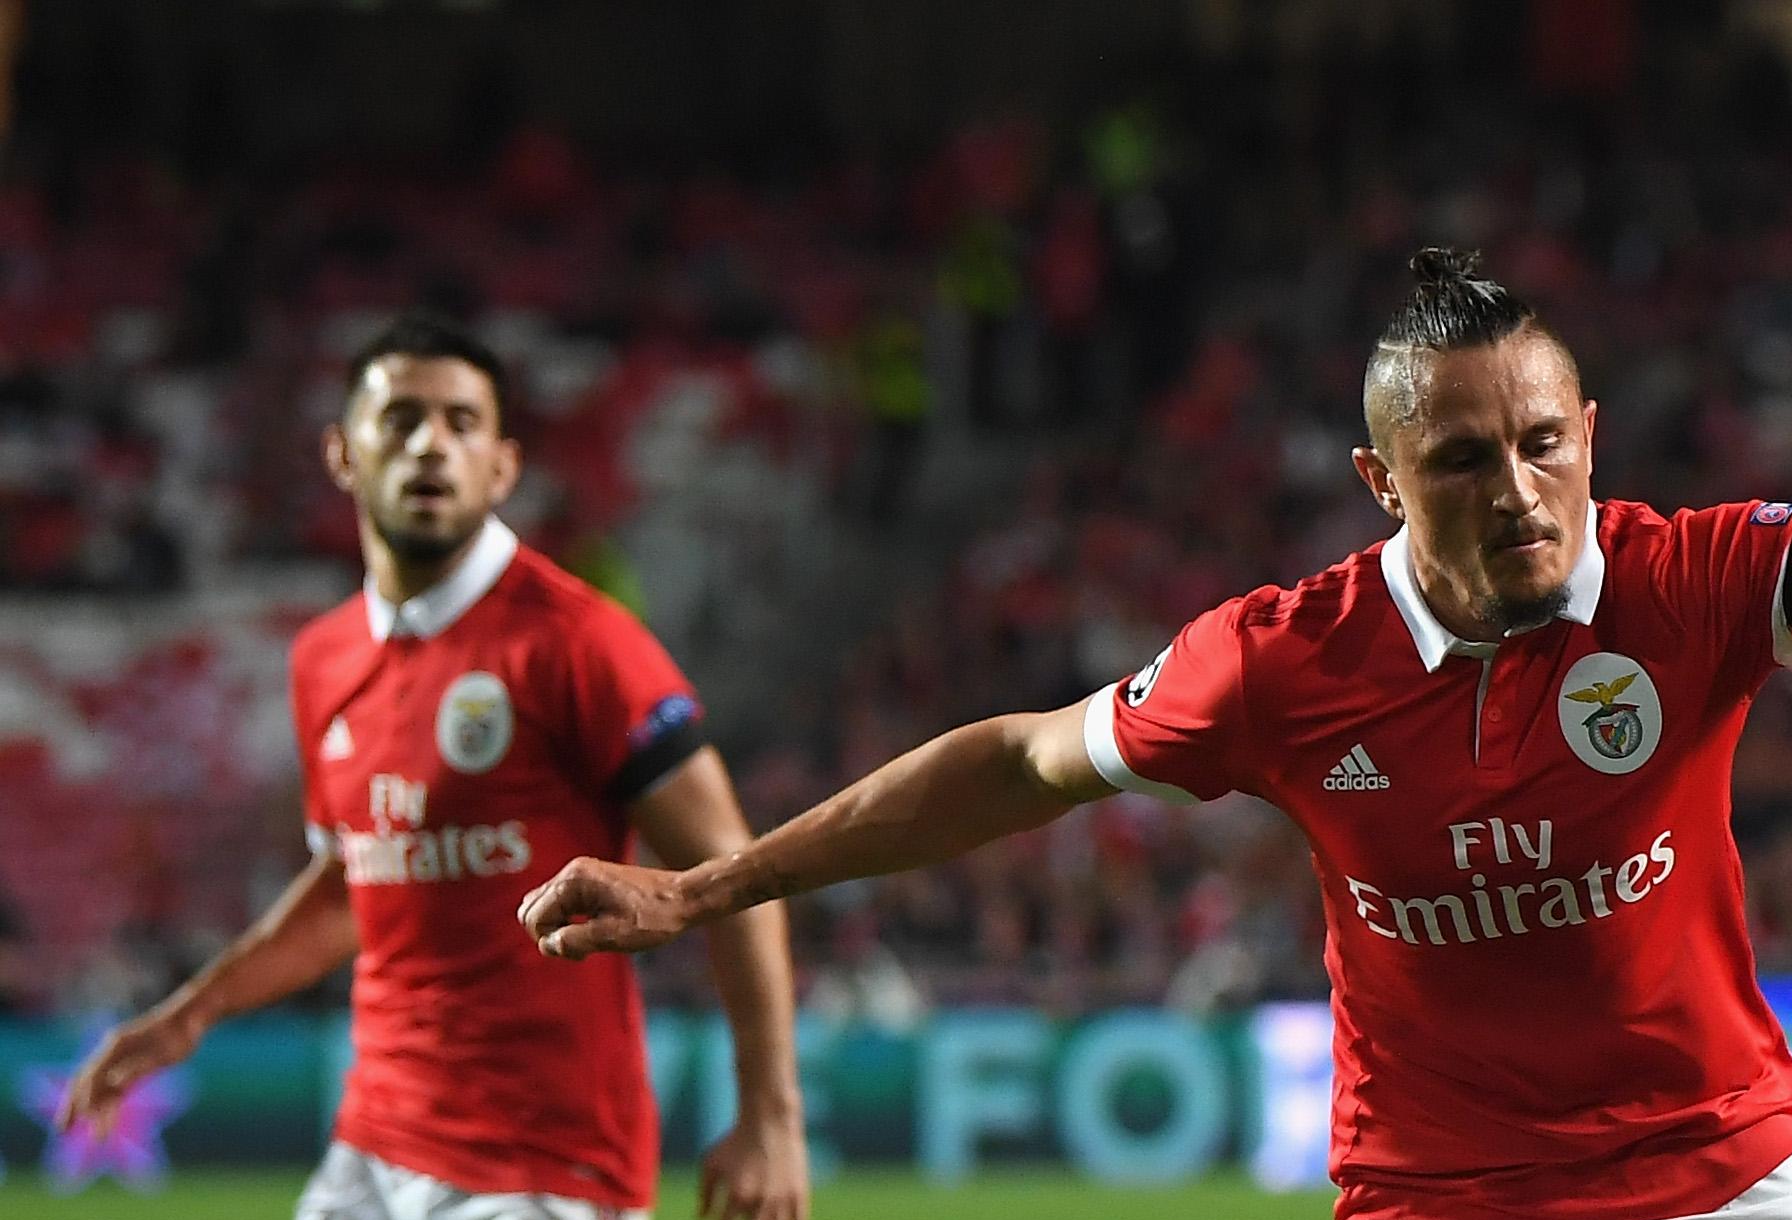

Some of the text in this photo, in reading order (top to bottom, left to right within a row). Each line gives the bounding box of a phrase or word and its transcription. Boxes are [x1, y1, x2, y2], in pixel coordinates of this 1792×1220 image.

[1323, 773, 1390, 790] adidas
[1449, 817, 1552, 870] Fly
[1345, 830, 1675, 945] Emirates
